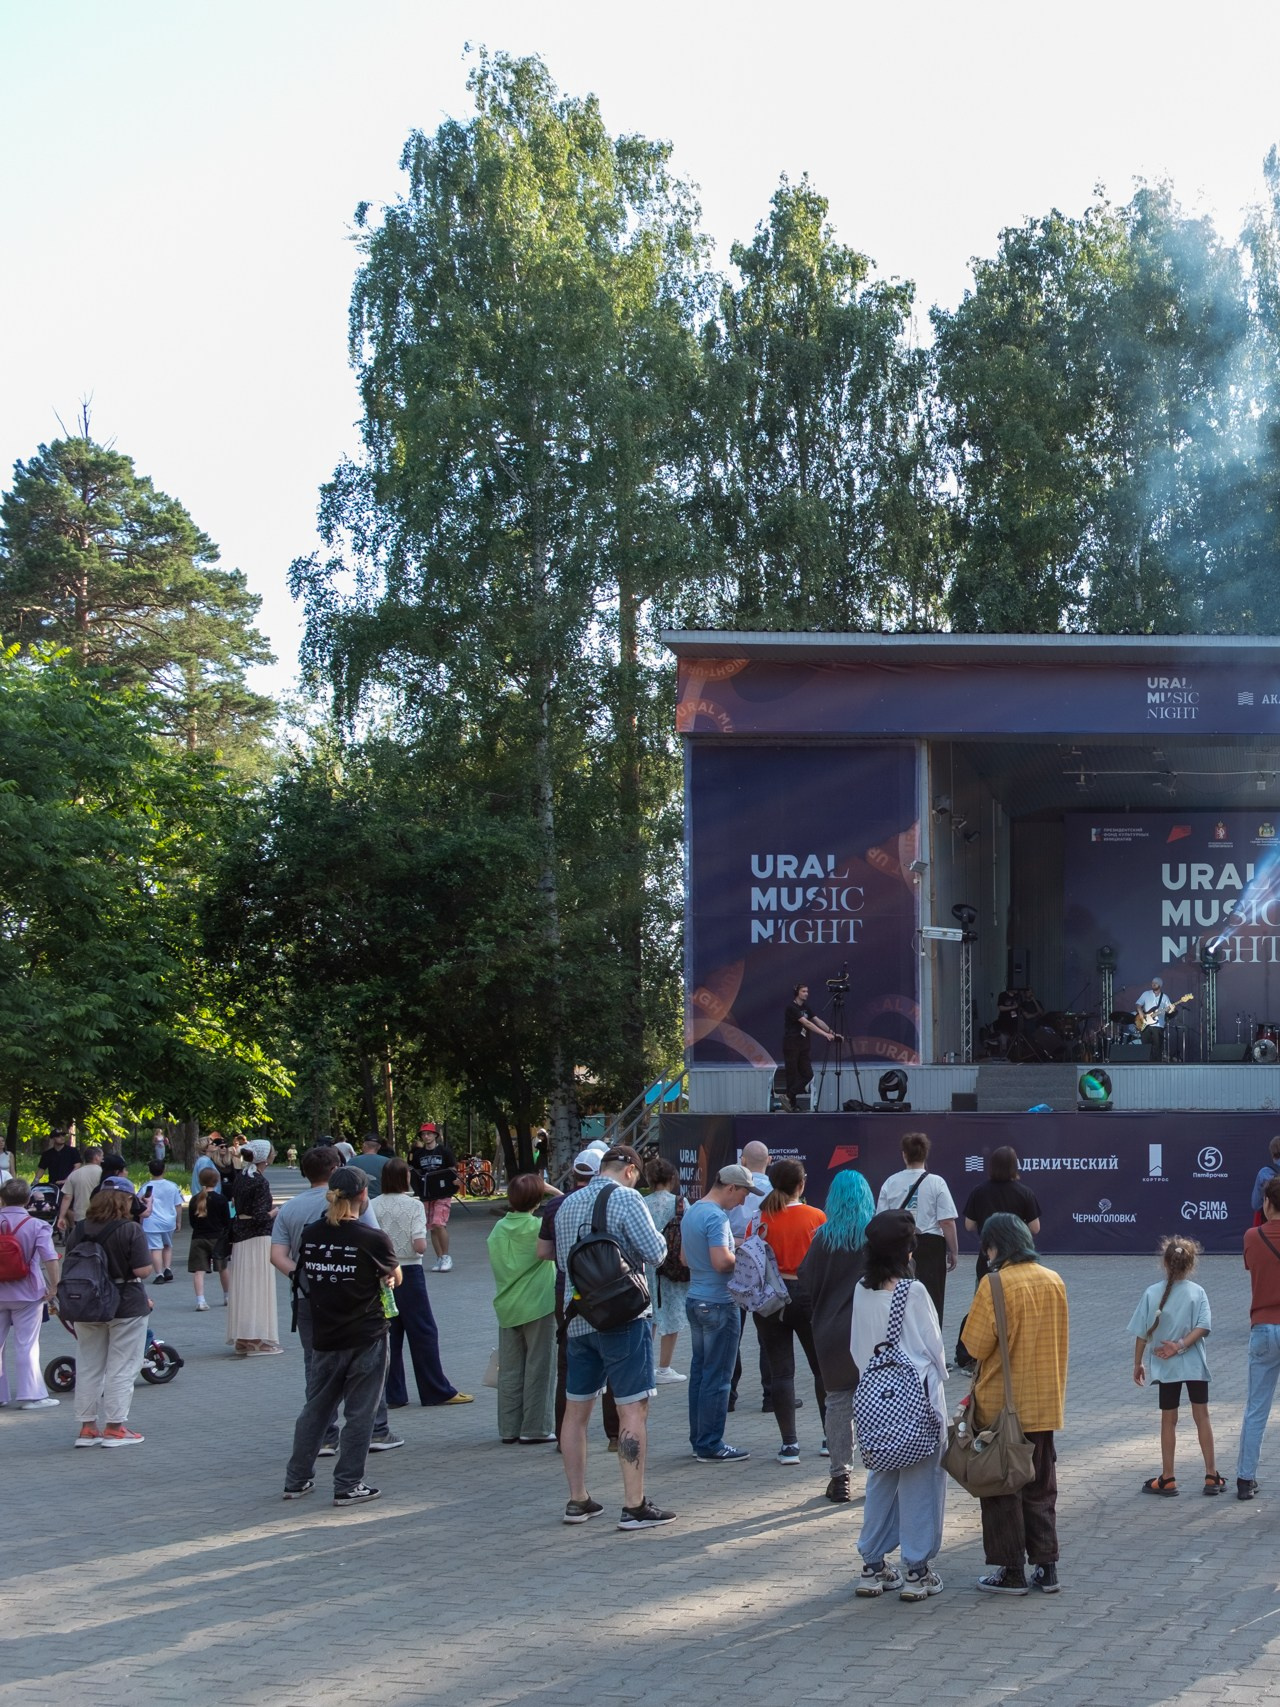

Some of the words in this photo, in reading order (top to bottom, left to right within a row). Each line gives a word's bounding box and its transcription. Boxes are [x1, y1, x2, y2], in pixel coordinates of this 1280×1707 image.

[1147, 677, 1193, 689] URAL
[1147, 691, 1200, 704] MUSIC
[1146, 706, 1199, 719] NIGHT
[751, 854, 850, 879] URAL
[1161, 863, 1271, 890] URAL
[751, 886, 865, 912] MUSIC
[751, 918, 863, 944] NIGHT
[768, 1148, 799, 1156] ДЕНТСКИЙ
[1016, 1155, 1119, 1170] ДЕМИЧЕСКИЙ
[1192, 1171, 1229, 1179] Пятёрочка
[1199, 1201, 1228, 1211] SIMA
[1199, 1210, 1228, 1220] LAND
[305, 1261, 357, 1273] МУЗЫКАНТ
